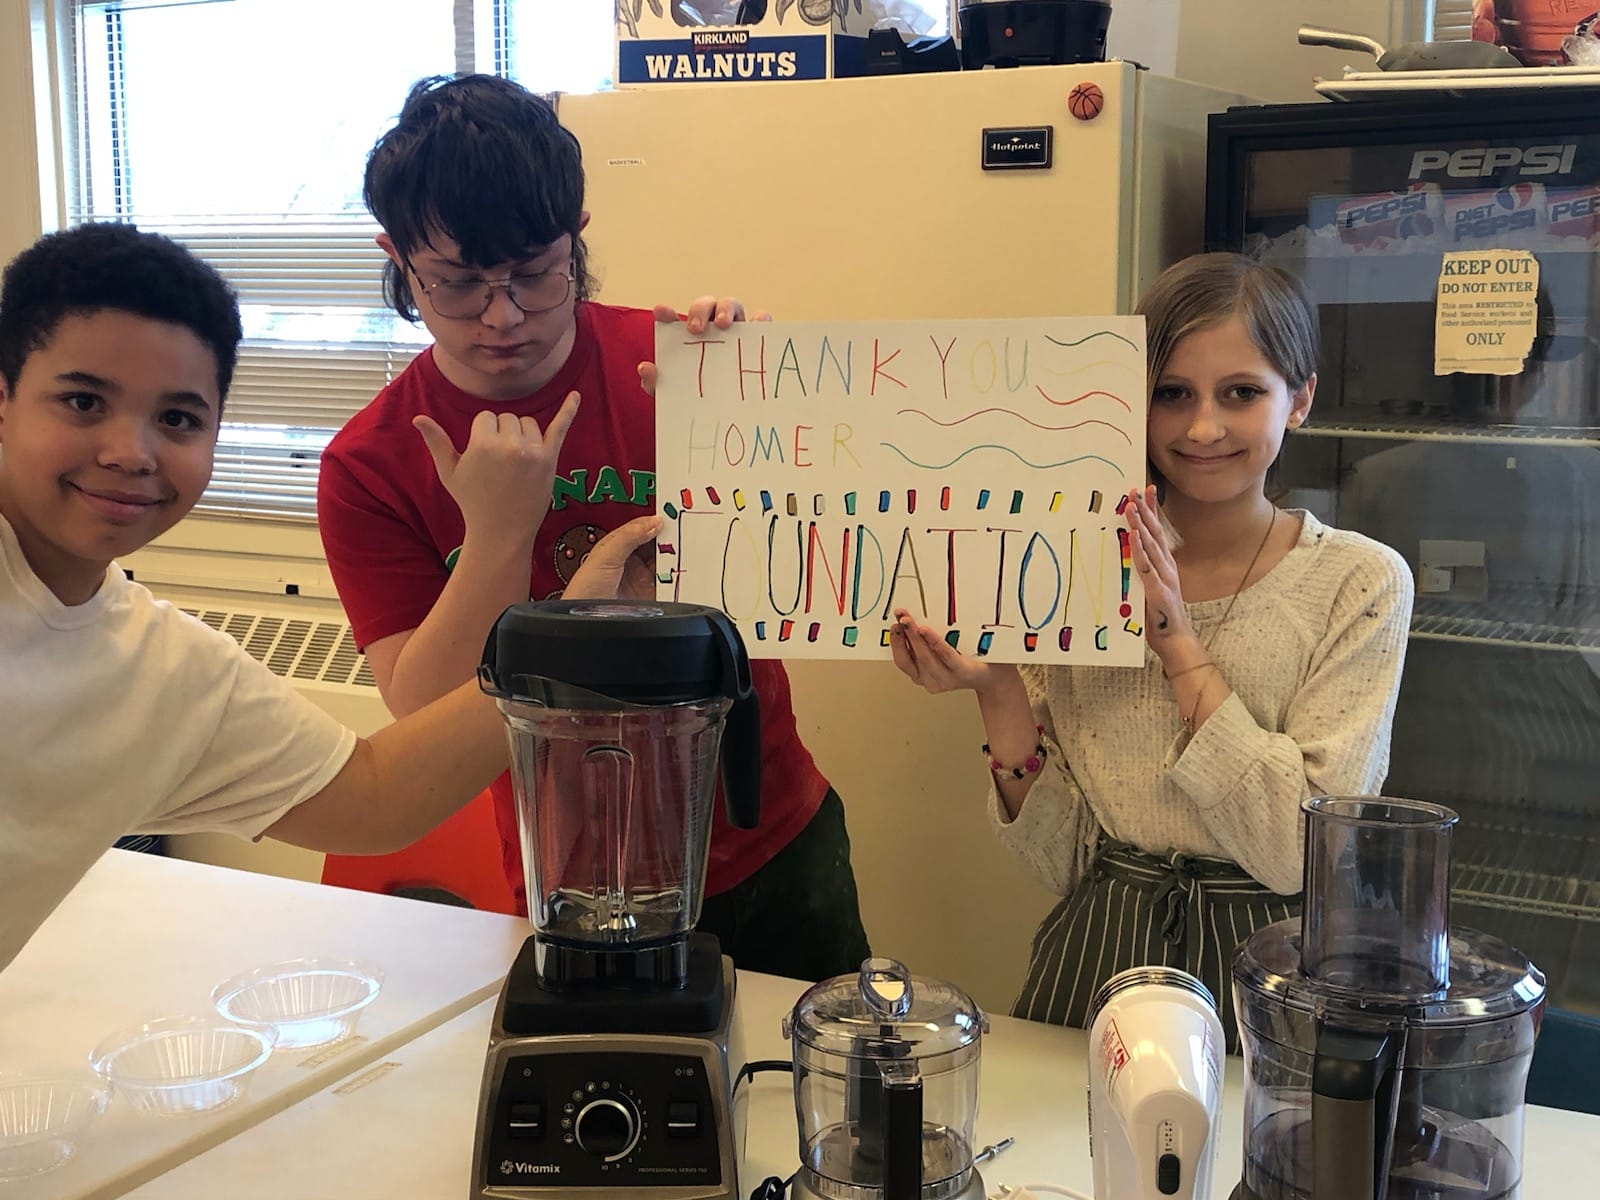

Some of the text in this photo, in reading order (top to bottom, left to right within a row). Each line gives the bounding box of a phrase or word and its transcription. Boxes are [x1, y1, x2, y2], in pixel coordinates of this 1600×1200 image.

[693, 32, 748, 45] KIRKLAND
[645, 52, 797, 79] WALNUTS
[991, 142, 1041, 152] Hotpoint
[1408, 145, 1577, 180] PEPSI
[1345, 191, 1427, 228] PEPSI
[1456, 203, 1496, 223] DIET
[1454, 208, 1537, 241] PEPSI
[1444, 258, 1533, 276] KEEP OUT
[1442, 281, 1533, 294] DO NOT ENTER
[1466, 332, 1506, 345] ONLY
[684, 335, 1029, 400] THANK YOU
[688, 417, 863, 474] HOMER
[672, 509, 1134, 630] FOUNDATION!
[515, 1162, 560, 1174] Vitamix
